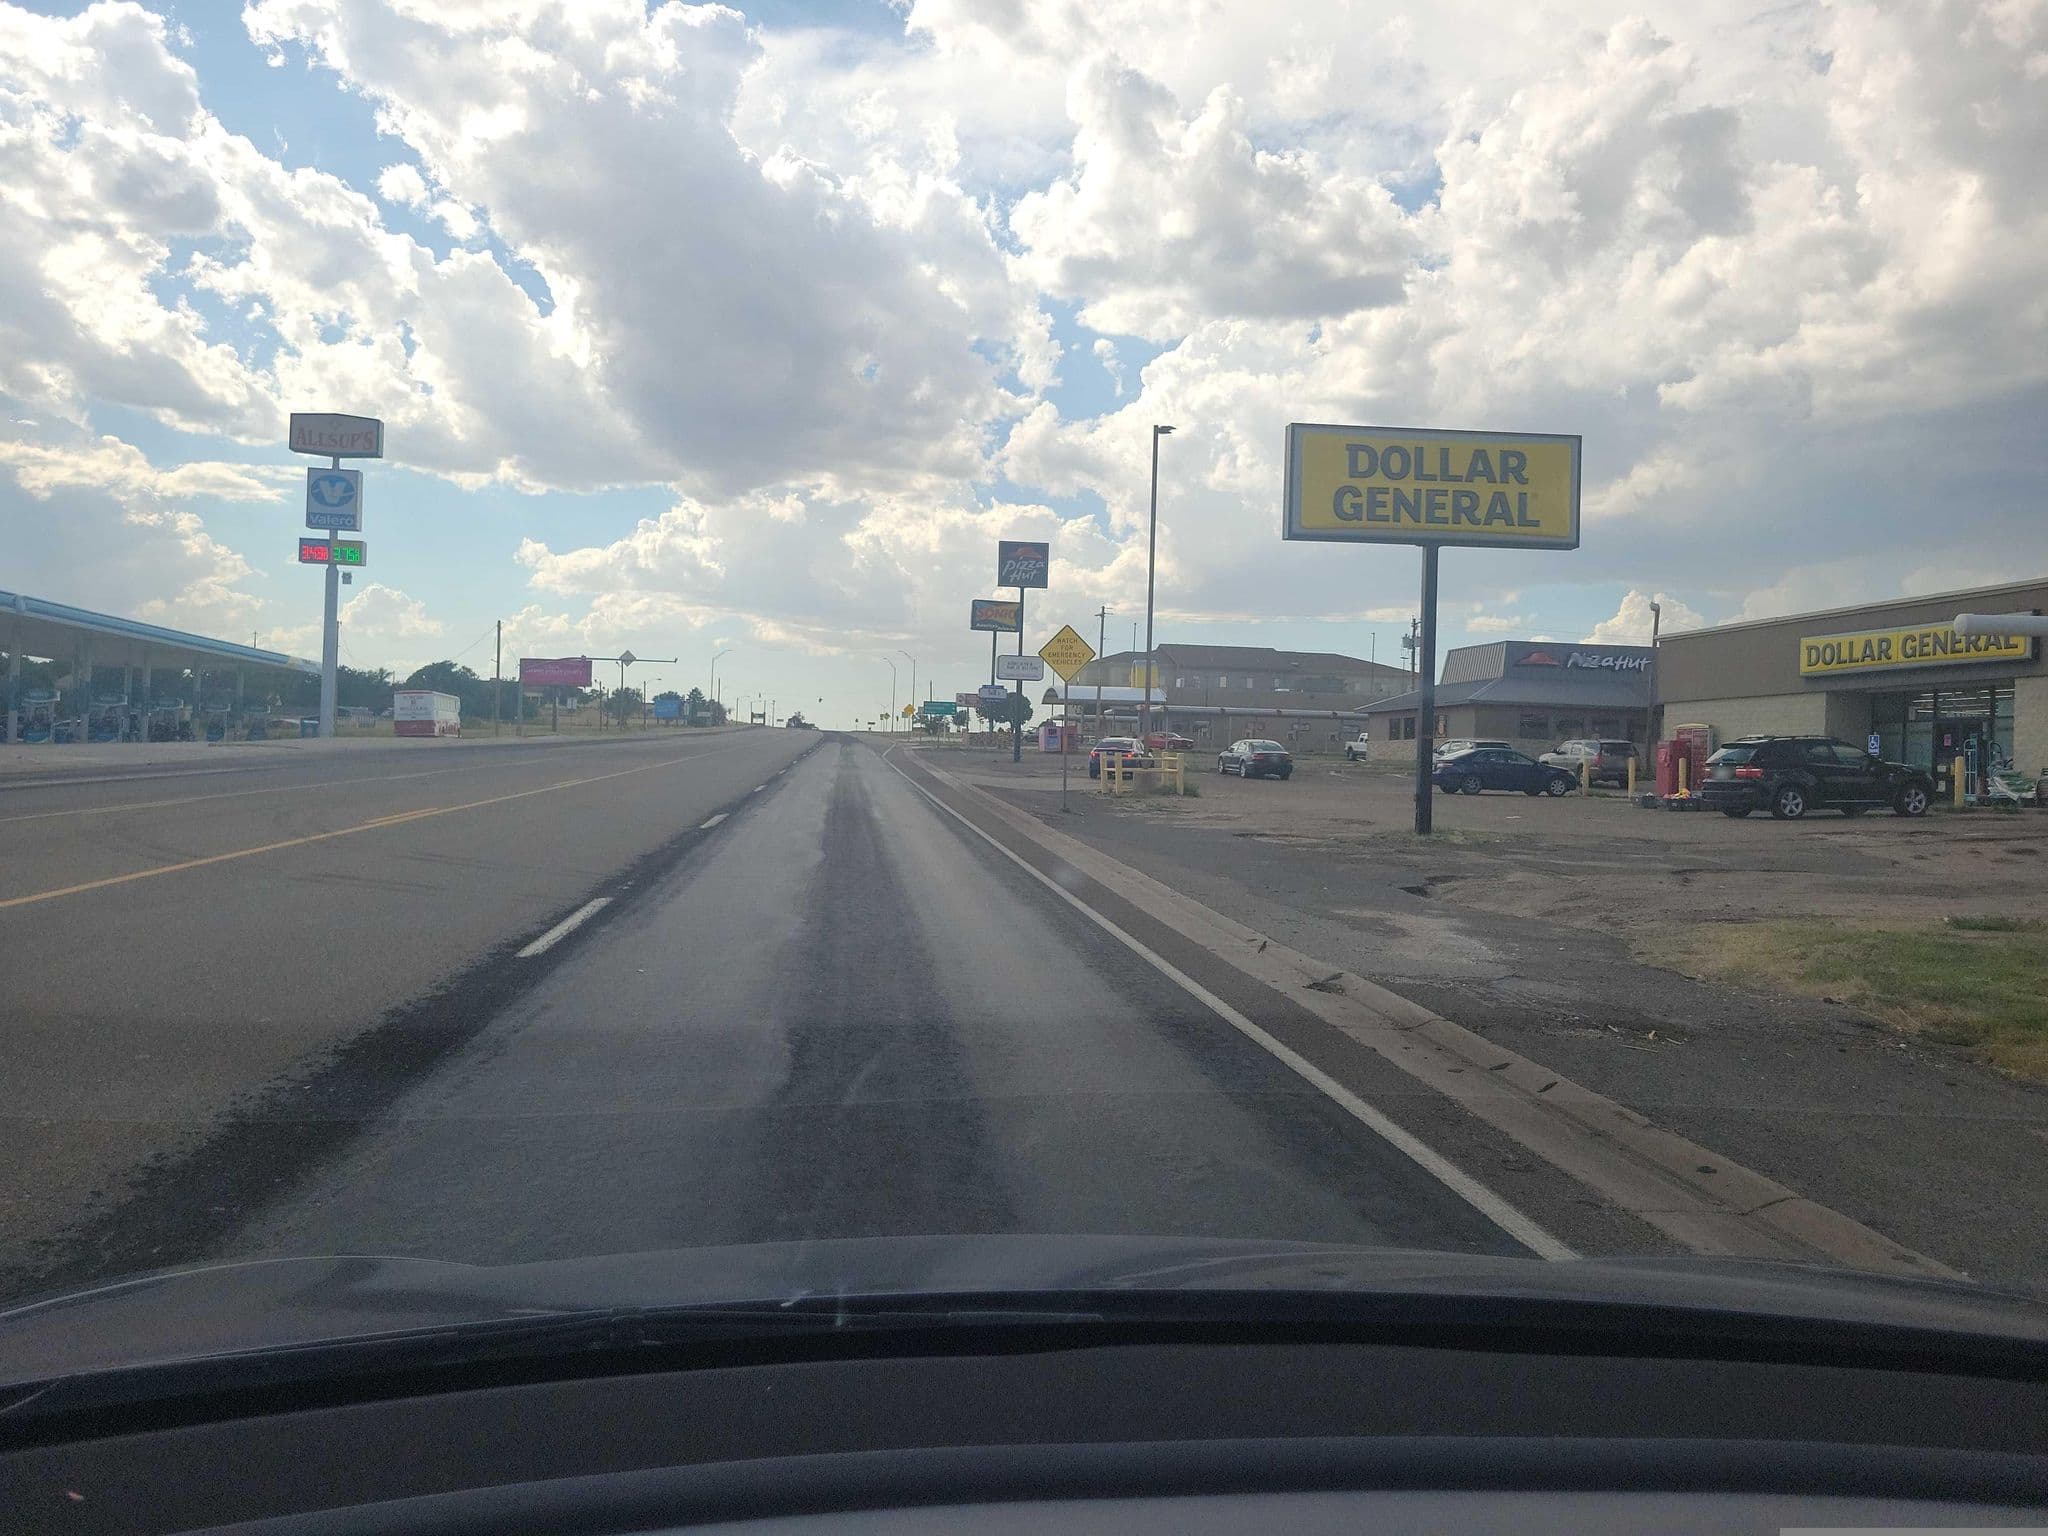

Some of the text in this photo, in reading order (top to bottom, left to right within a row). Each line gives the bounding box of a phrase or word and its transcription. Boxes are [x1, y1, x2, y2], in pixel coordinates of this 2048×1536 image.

[295, 427, 375, 451] ALLSUP'S
[1345, 443, 1529, 485] DOLLAR
[1332, 485, 1541, 529] GENERAL
[310, 513, 353, 527] Valero
[1008, 570, 1039, 583] Hut
[1048, 651, 1087, 659] EMERGENCY
[1807, 629, 2019, 667] DOLLAR GENERAL
[1053, 658, 1082, 666] VEHICLES
